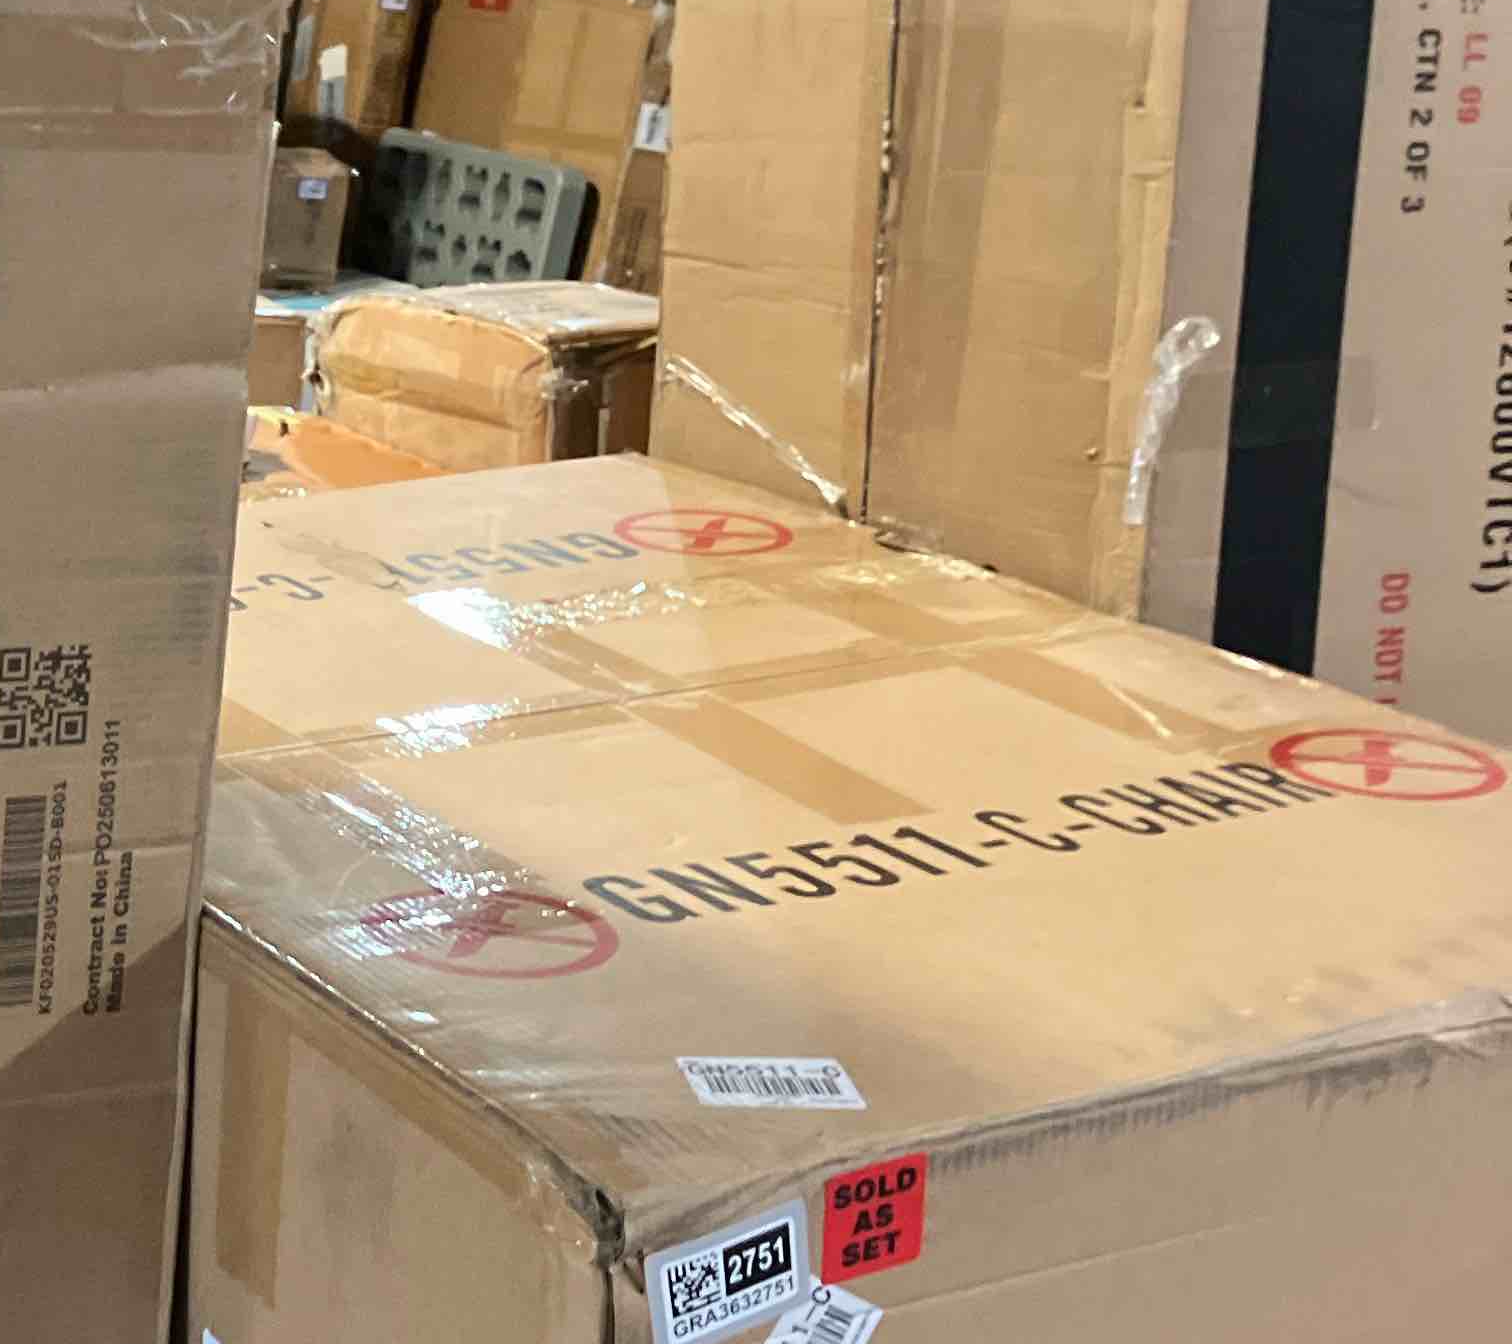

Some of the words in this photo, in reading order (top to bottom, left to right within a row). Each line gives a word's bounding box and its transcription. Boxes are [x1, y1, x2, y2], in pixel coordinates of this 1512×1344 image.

[1416, 28, 1443, 96] CTN
[1410, 107, 1434, 128] 2
[1405, 141, 1431, 183] OF
[1400, 195, 1427, 215] 3
[1379, 571, 1410, 615] DO
[1371, 626, 1405, 694] NOT
[580, 760, 1336, 925] GN5511-C-CHAIR
[113, 850, 134, 918] China
[83, 915, 106, 1017] Contract
[833, 1165, 918, 1210] SOLD
[852, 1202, 895, 1236] AS
[726, 1234, 787, 1286] 2751
[840, 1230, 902, 1268] SET
[672, 1276, 796, 1339] GRA3632751
